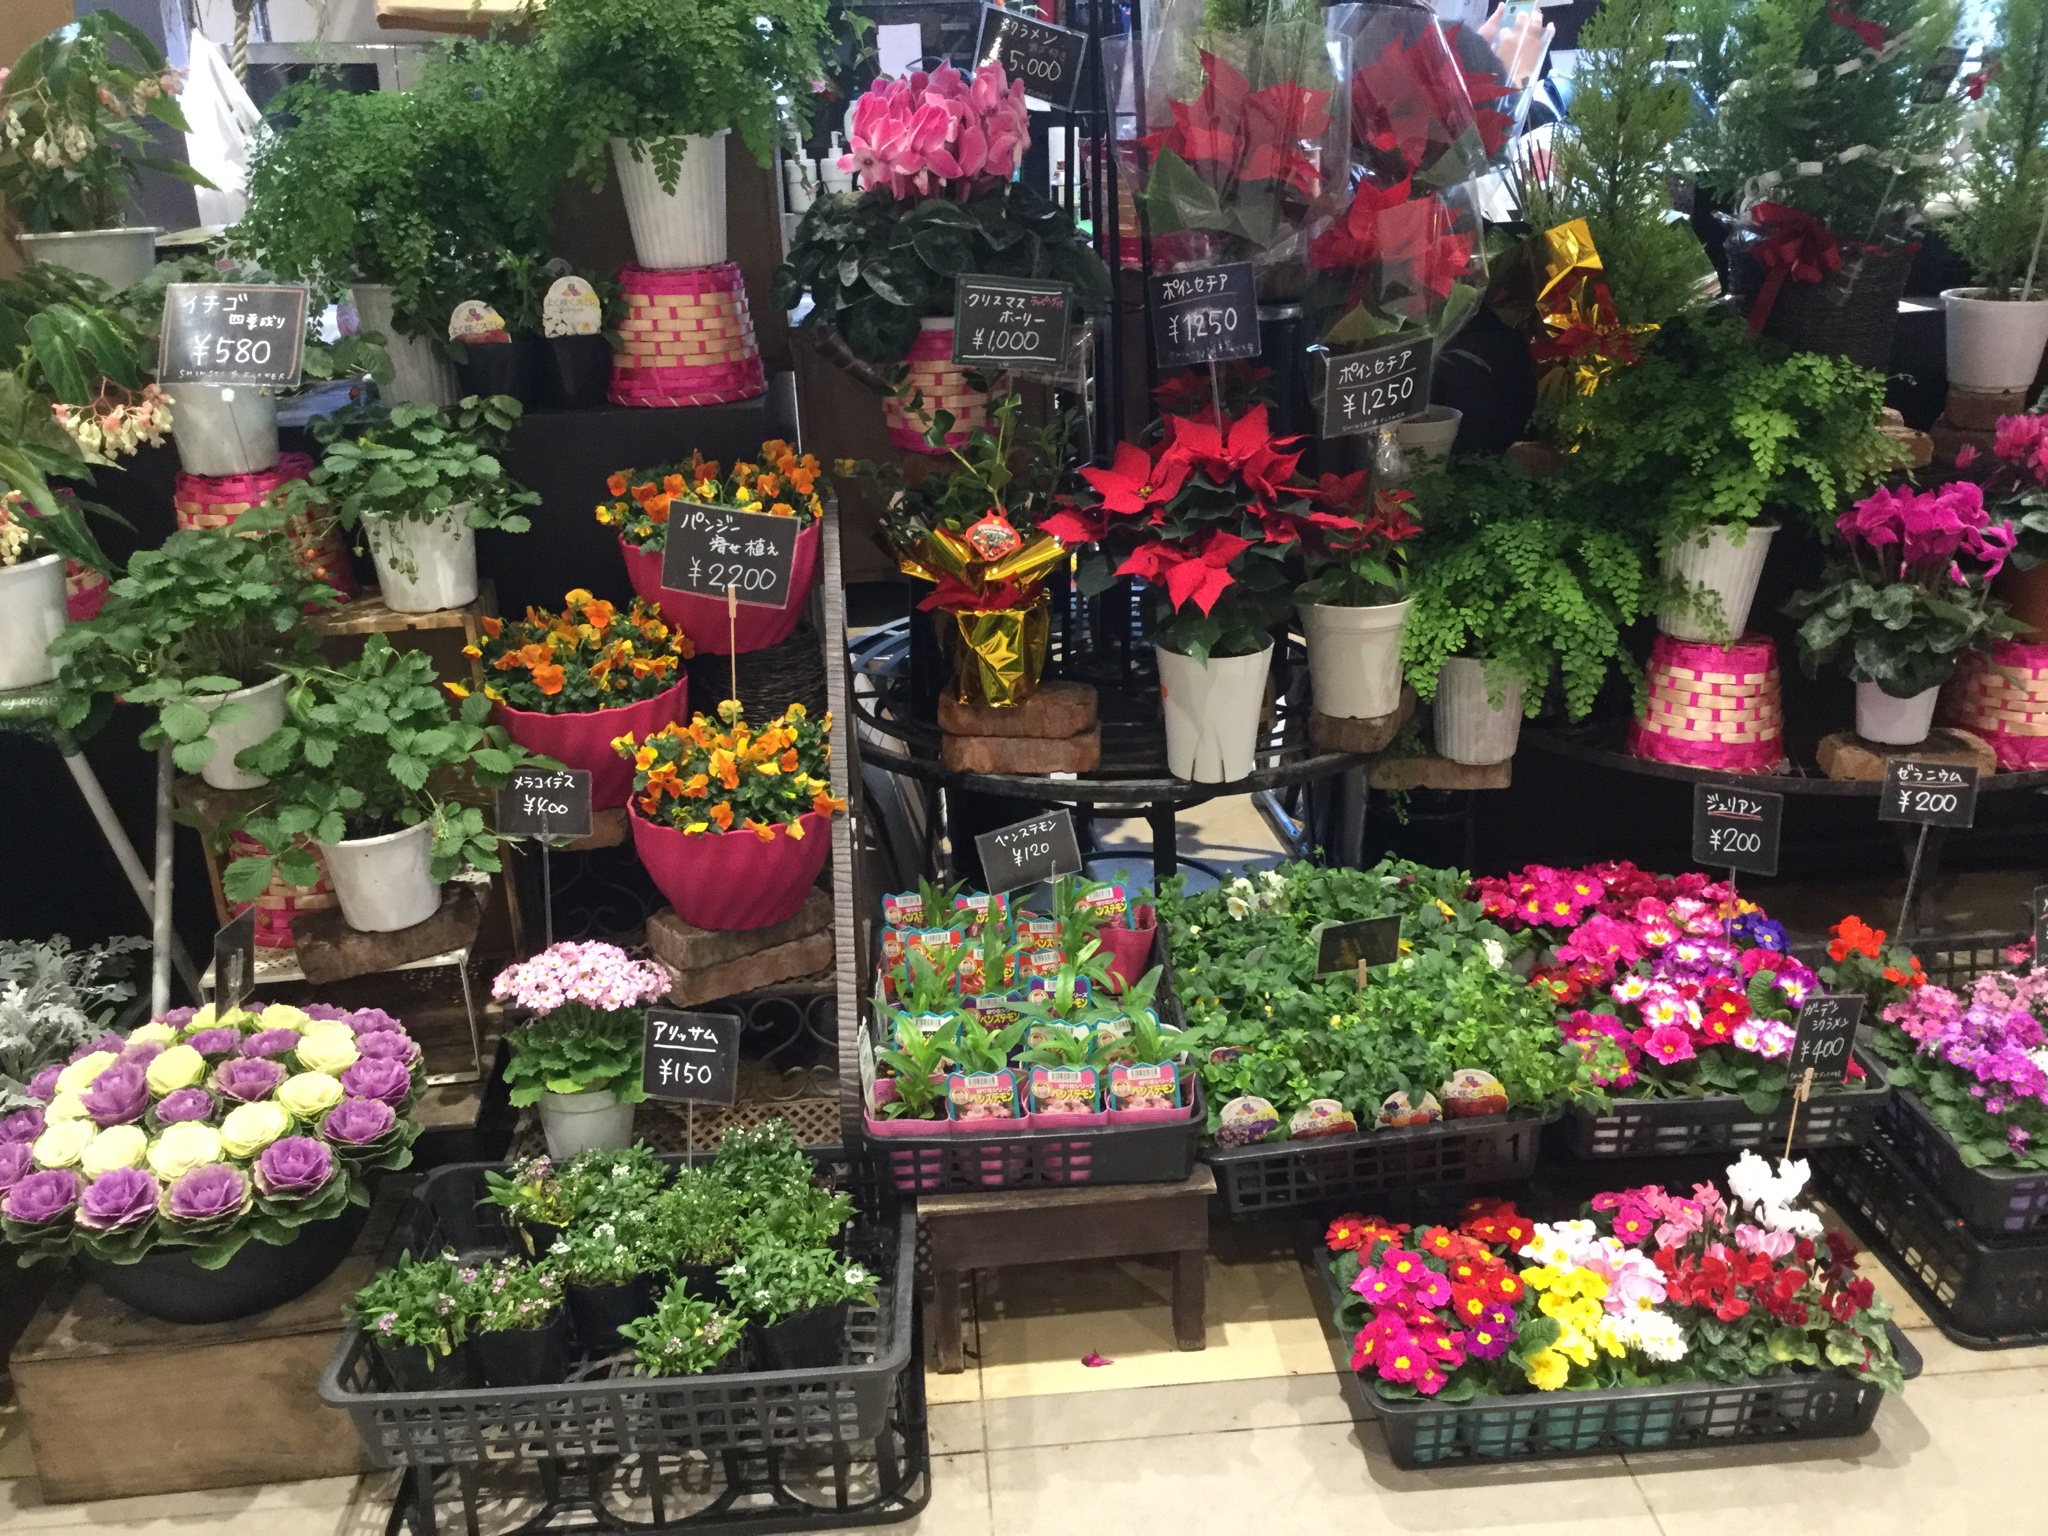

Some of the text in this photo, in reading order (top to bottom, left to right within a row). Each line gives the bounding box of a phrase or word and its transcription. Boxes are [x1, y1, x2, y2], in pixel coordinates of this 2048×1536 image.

[1001, 18, 1058, 45] クラメン
[1162, 273, 1228, 300] ポインセチア
[182, 292, 249, 315] イチゴ
[968, 293, 1026, 309] クリスマス
[228, 313, 286, 330] 四季成り
[999, 310, 1046, 327] ホーリー
[192, 333, 272, 366] ¥580
[972, 327, 1040, 352] ¥1,000
[1338, 350, 1413, 385] ポインセチア
[1342, 376, 1414, 420] ¥1,250
[680, 511, 741, 534] パンジー
[708, 533, 779, 557] 寄せ植え
[687, 555, 777, 593] ¥2,200
[513, 770, 575, 790] メラコイデス
[1896, 763, 1963, 783] ゼラニウム
[522, 793, 569, 816] ¥400
[1897, 789, 1957, 814] ¥200
[994, 819, 1057, 847] ペンステモン
[1708, 827, 1761, 853] ¥200
[1011, 842, 1050, 868] ¥120
[1803, 1000, 1840, 1017] ガーデン
[652, 1020, 719, 1045] アリッサム
[1811, 1017, 1850, 1032] シクラメン
[1800, 1036, 1845, 1065] ¥400
[658, 1057, 712, 1085] ¥150
